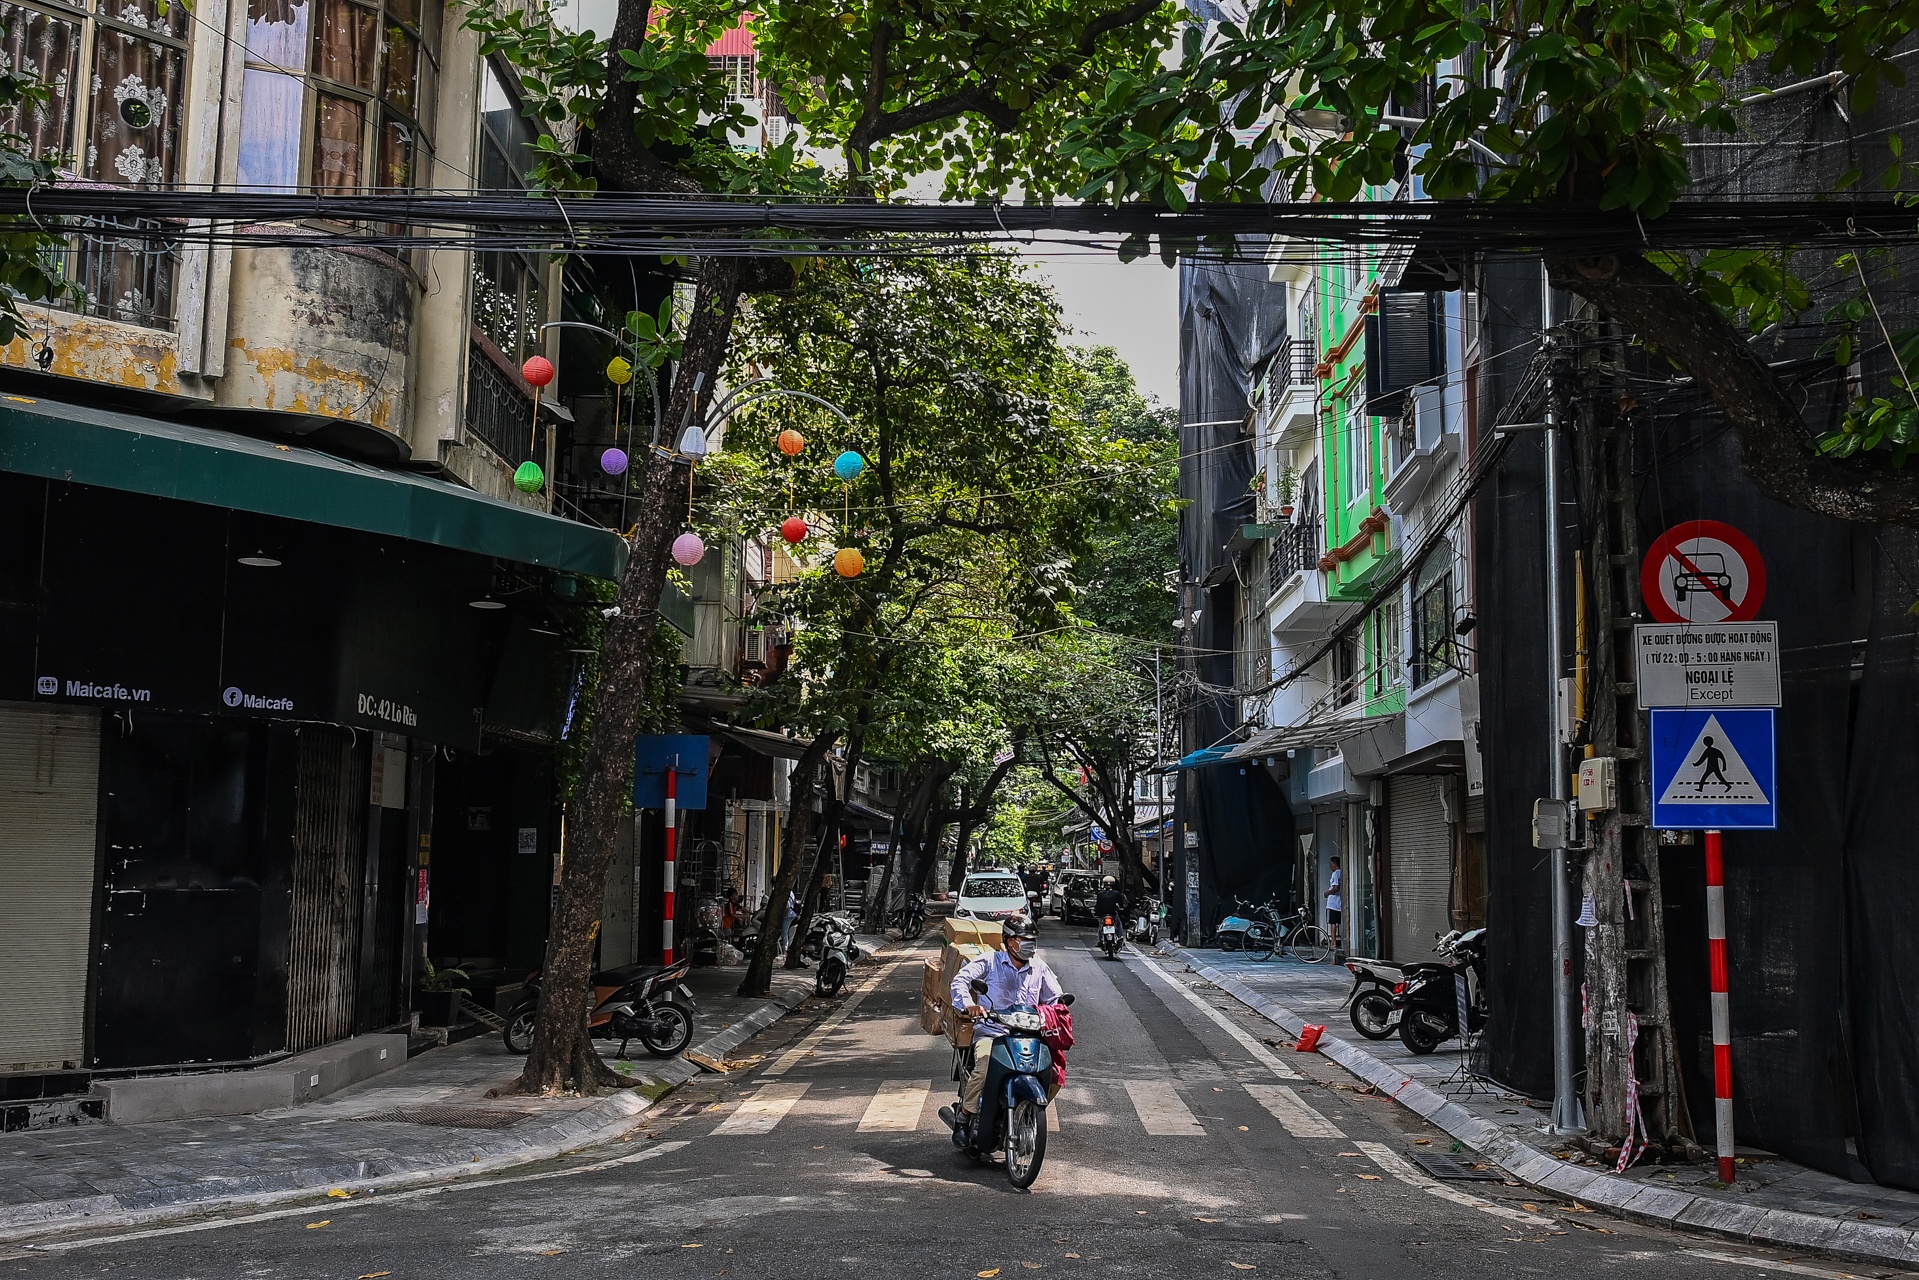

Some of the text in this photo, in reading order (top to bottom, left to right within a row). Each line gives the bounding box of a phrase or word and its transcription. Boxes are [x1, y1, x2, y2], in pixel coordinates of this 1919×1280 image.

[1642, 634, 1653, 646] XE
[1654, 632, 1675, 646] QUÉT
[1705, 632, 1727, 646] ĐƯỢC
[1728, 632, 1749, 646] HOẠT
[1750, 630, 1772, 646] ĐỘNG
[1720, 650, 1742, 663] HÀNG
[1685, 667, 1735, 686] NGOẠI LỆ
[66, 680, 151, 702] Maicafe.vn
[1690, 688, 1734, 702] Except
[243, 694, 294, 711] Maicafe
[357, 693, 377, 717] ĐC:
[378, 699, 391, 720] 42
